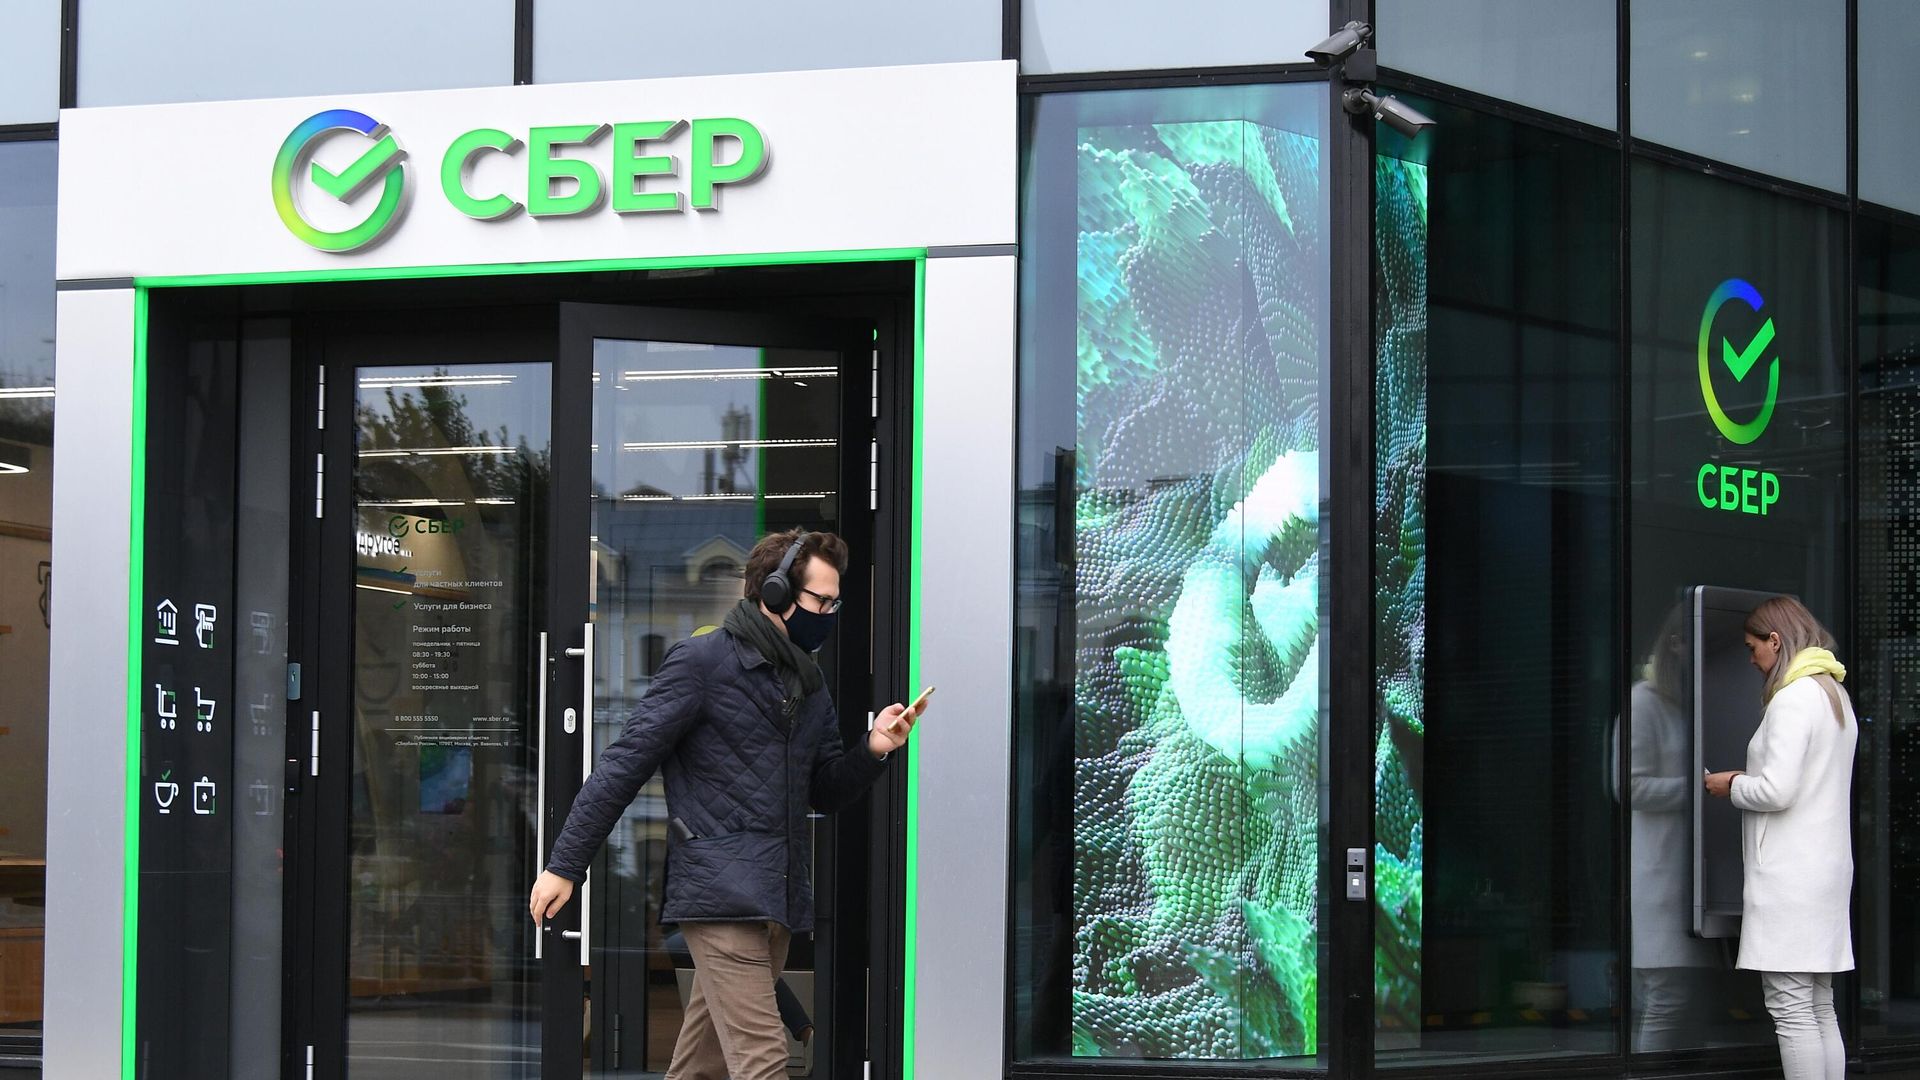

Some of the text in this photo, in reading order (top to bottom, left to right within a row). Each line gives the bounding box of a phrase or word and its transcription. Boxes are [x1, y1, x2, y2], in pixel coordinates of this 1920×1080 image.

[440, 118, 770, 219] СБЕР
[1697, 463, 1780, 515] СБЕР
[415, 519, 465, 534] СБЕР
[413, 579, 503, 588] для частных клиентов
[413, 601, 492, 611] Услуги для бизнеса
[412, 625, 472, 634] Режим работы
